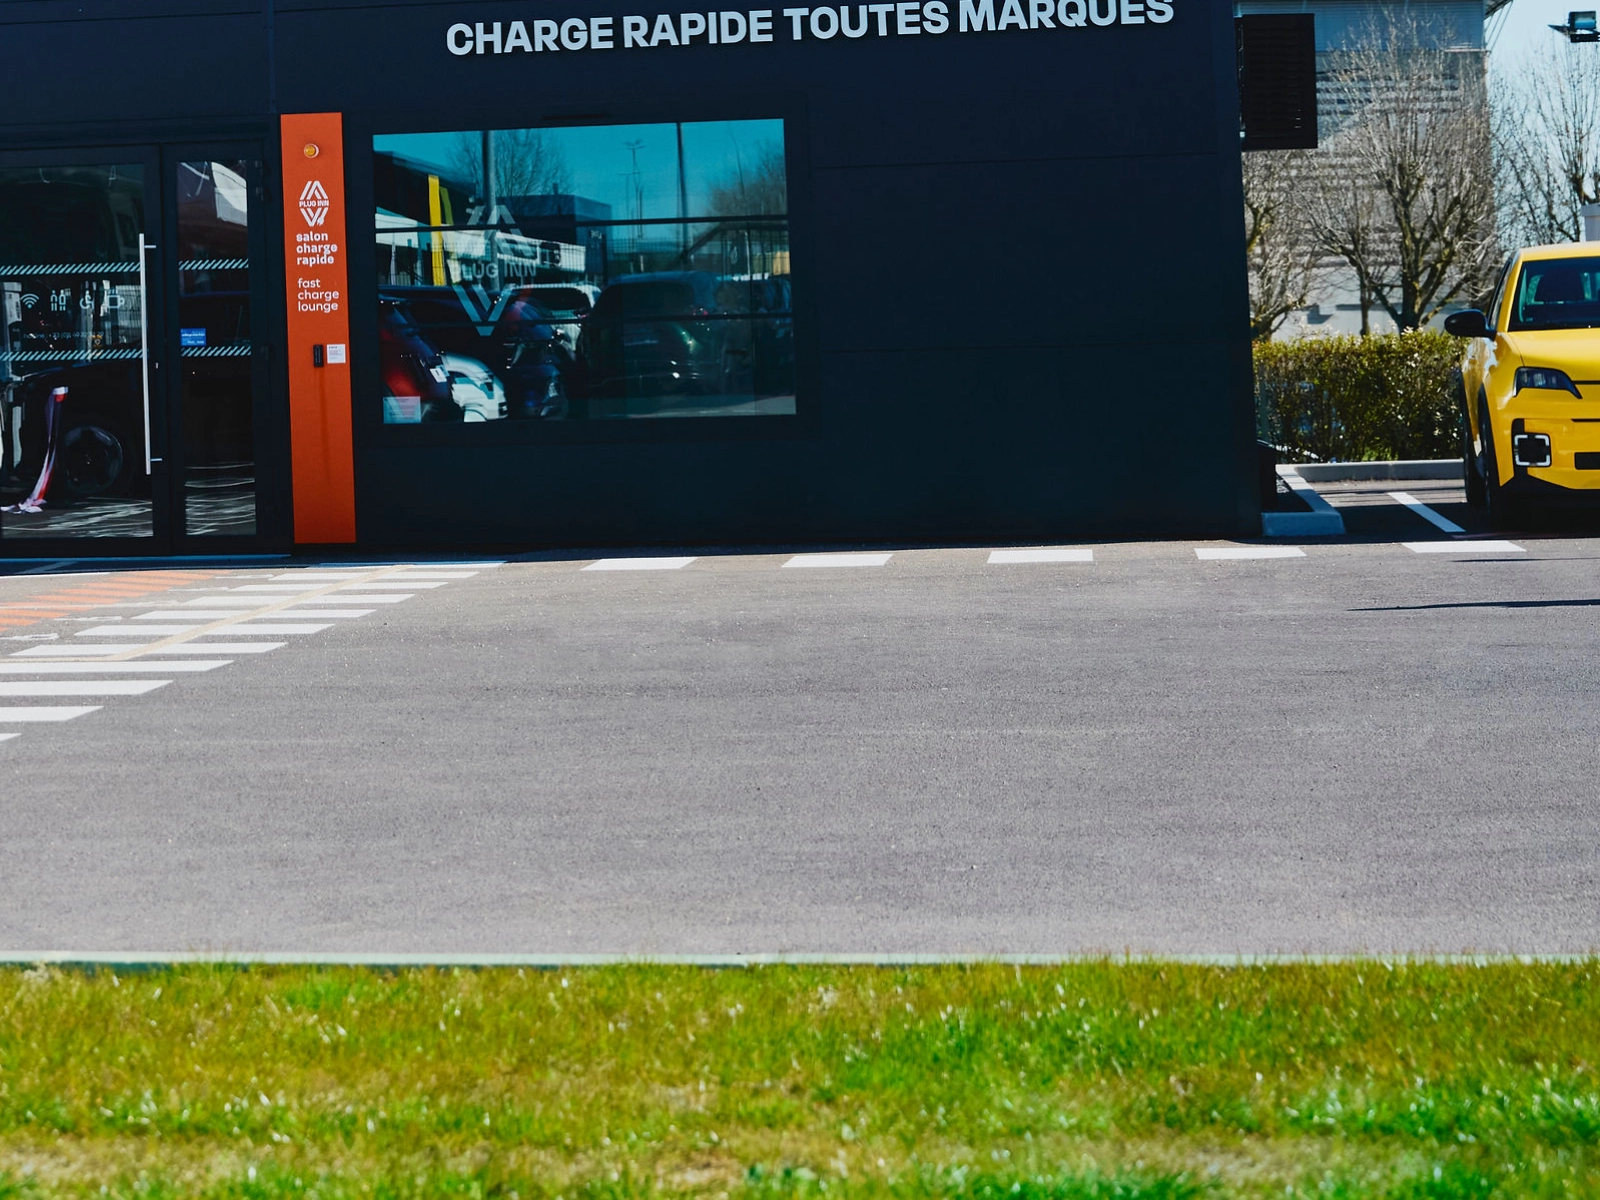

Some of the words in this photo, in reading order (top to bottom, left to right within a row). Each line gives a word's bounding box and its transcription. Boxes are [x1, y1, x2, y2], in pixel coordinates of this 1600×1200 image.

[446, 17, 614, 56] CHARGE
[622, 10, 774, 48] RAPIDE
[783, 0, 949, 41] TOUTES
[296, 231, 329, 242] salon
[296, 243, 338, 255] charge
[296, 254, 335, 267] rapide
[298, 278, 321, 288] fast
[298, 290, 339, 301] charge
[298, 301, 339, 313] lounge
